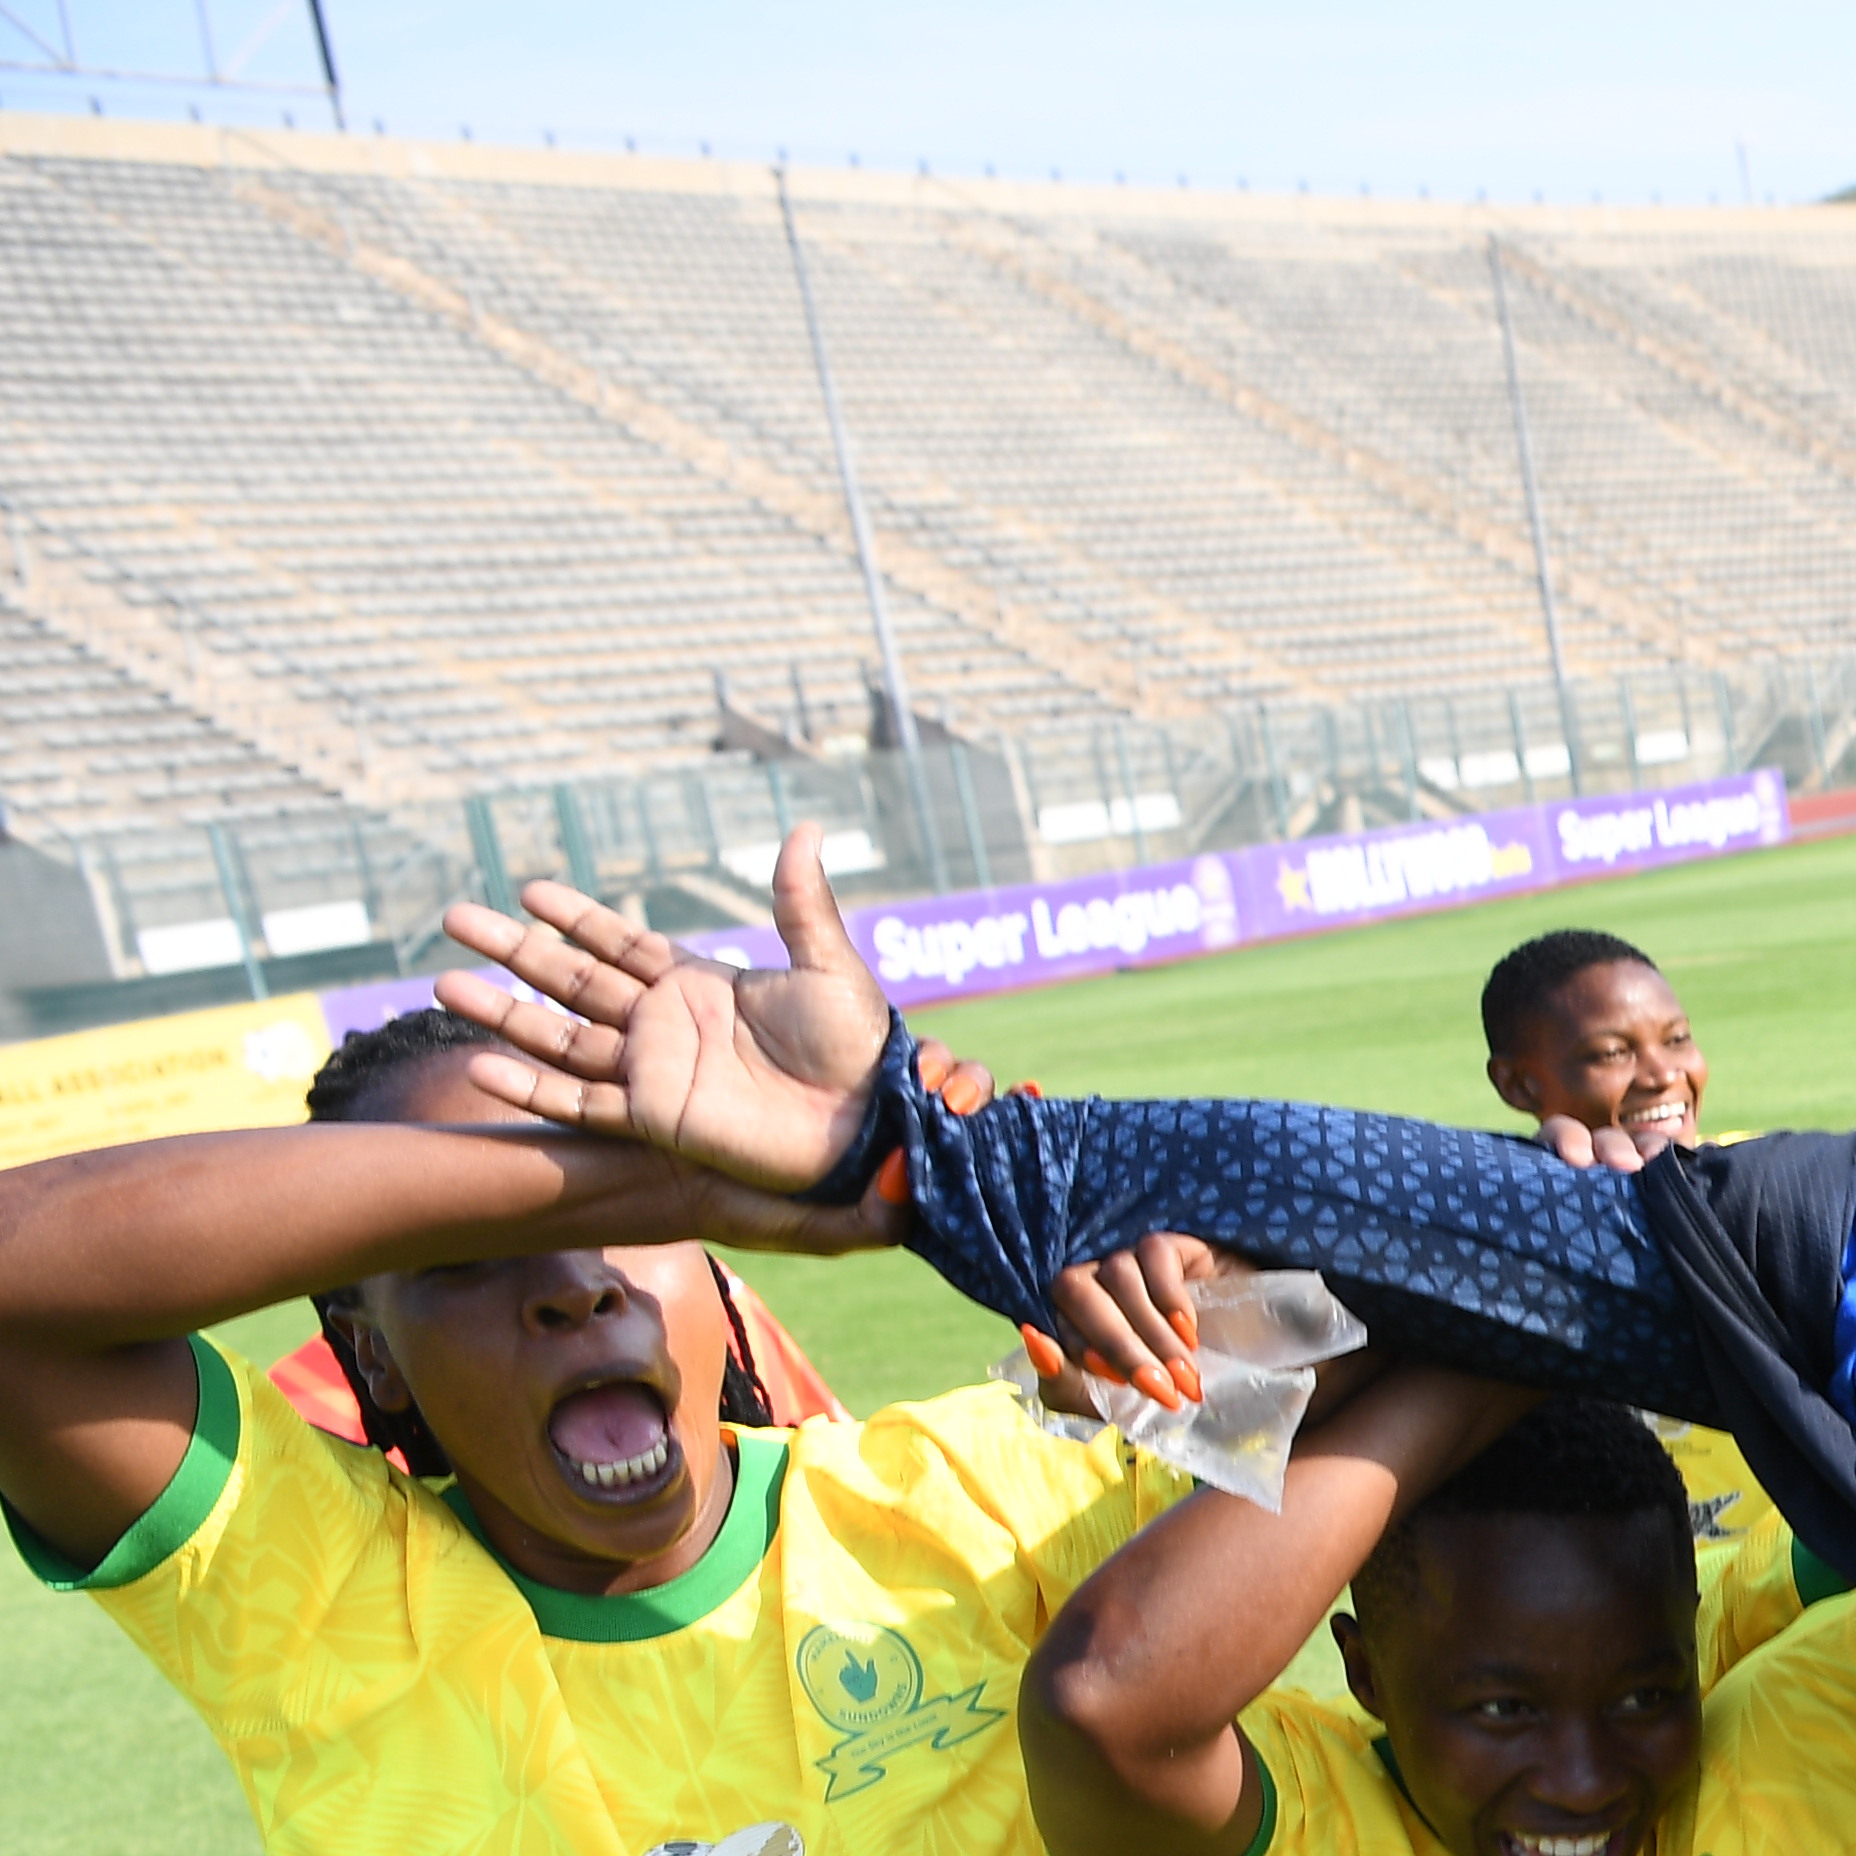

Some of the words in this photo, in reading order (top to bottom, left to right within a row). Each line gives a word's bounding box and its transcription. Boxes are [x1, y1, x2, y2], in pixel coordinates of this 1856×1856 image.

[1557, 807, 1653, 864] Super
[1653, 794, 1760, 849] League
[873, 912, 1028, 985] Super
[1031, 882, 1200, 959] League
